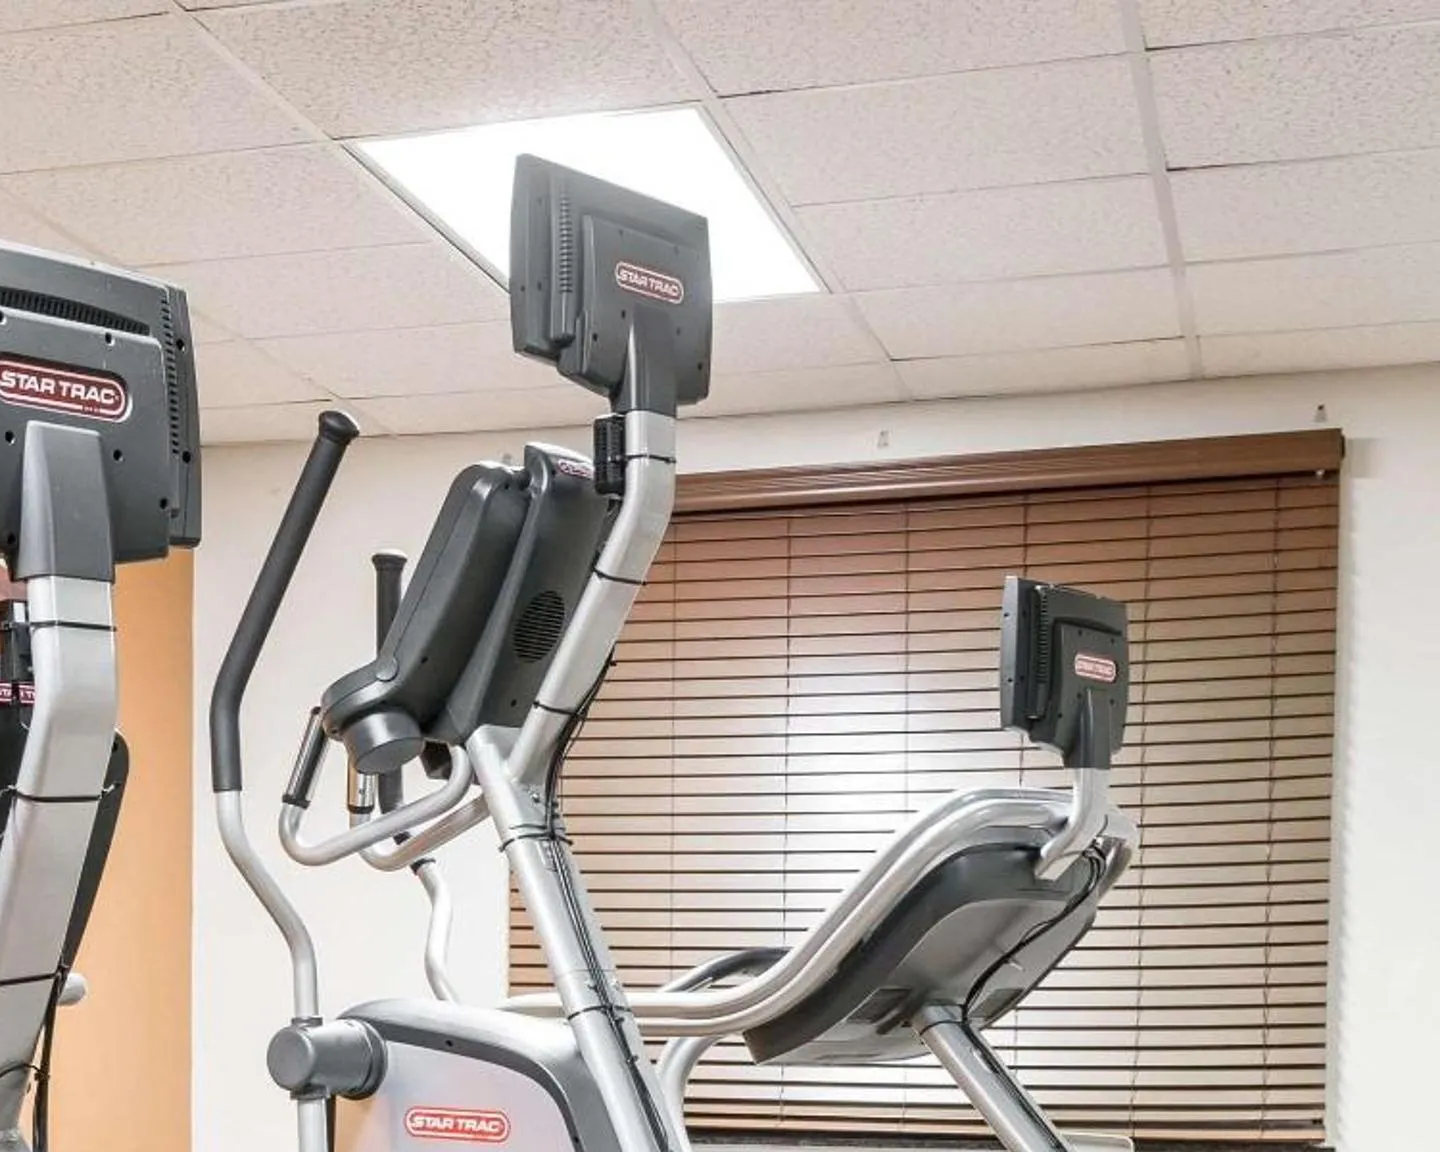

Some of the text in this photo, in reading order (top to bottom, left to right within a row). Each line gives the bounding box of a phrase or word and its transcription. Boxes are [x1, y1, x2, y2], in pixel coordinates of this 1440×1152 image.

[619, 269, 680, 297] STAR TRAC
[58, 381, 116, 405] TRAC
[412, 1116, 502, 1133] STAR TRAC
